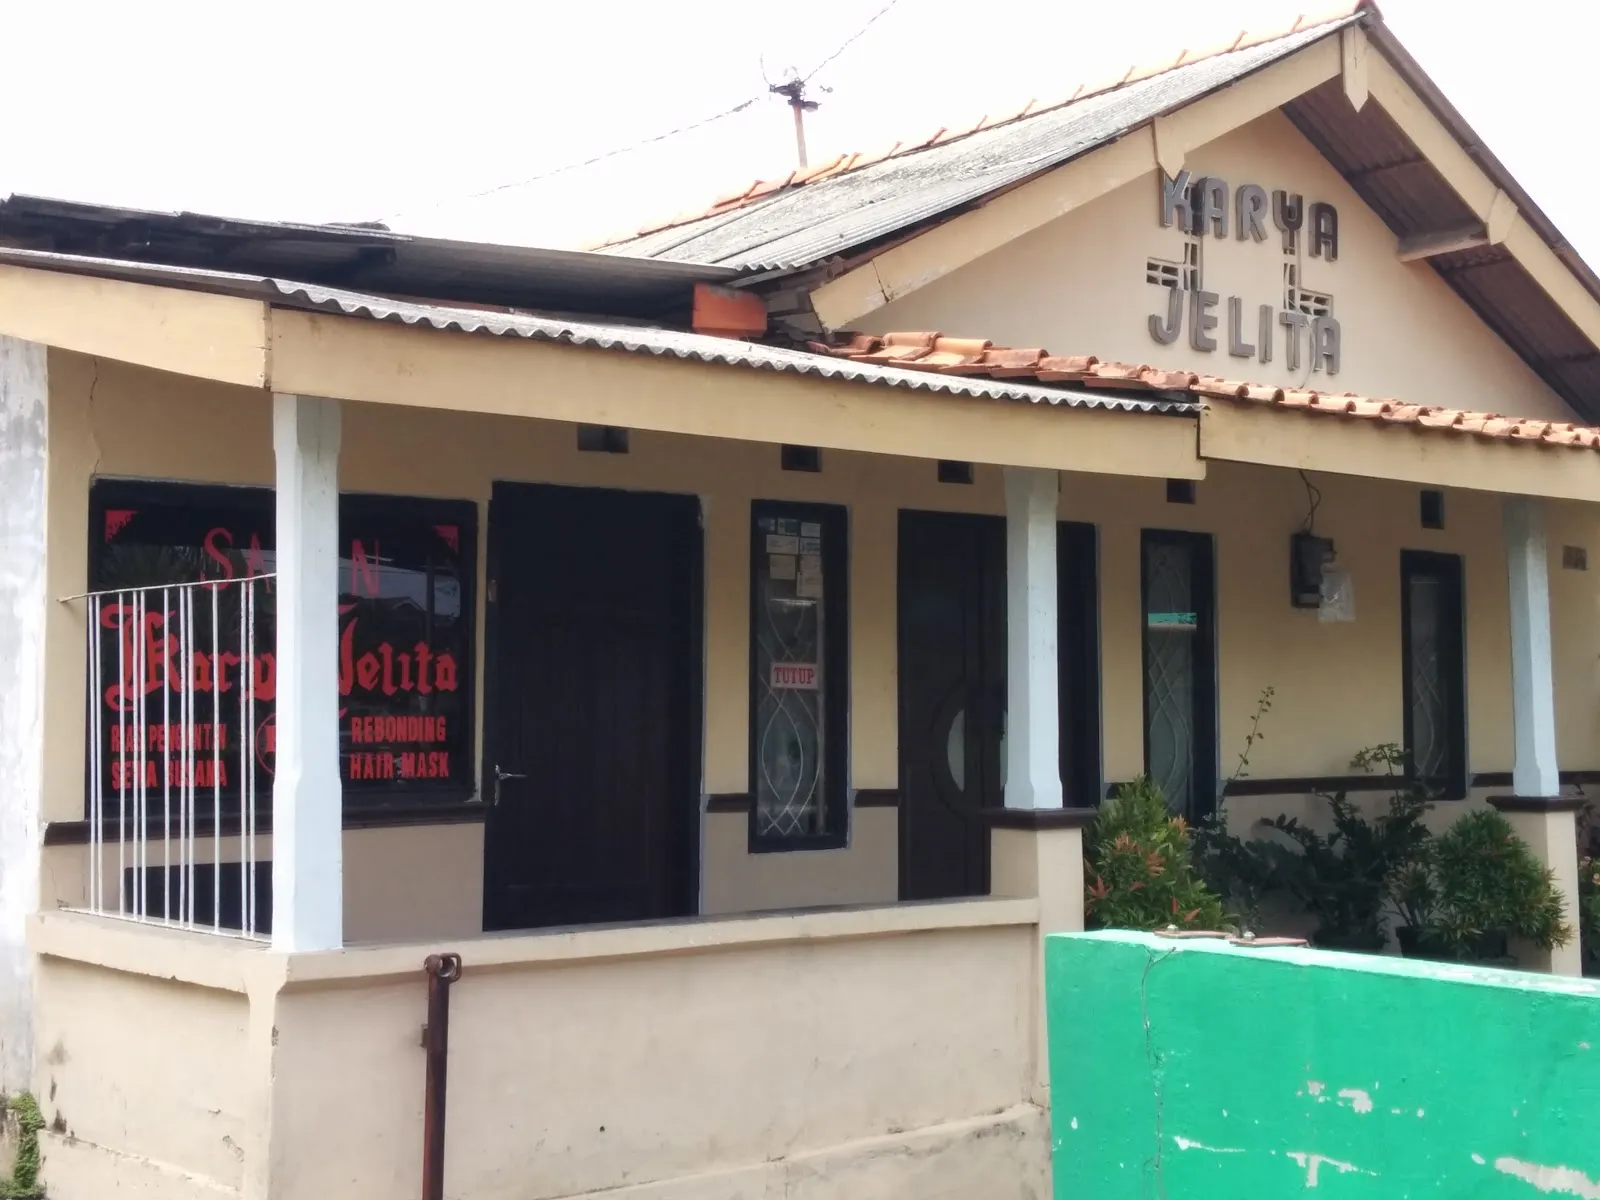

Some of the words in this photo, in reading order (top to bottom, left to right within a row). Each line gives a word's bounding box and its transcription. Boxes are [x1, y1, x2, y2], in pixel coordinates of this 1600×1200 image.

[1158, 168, 1338, 262] KARYA
[1148, 286, 1341, 375] JELITA
[200, 527, 379, 596] SAN
[100, 603, 277, 712] Kary
[773, 666, 815, 684] TUTUP
[351, 716, 447, 743] REBONDING
[350, 752, 394, 779] HAIR
[401, 752, 449, 778] MASK
